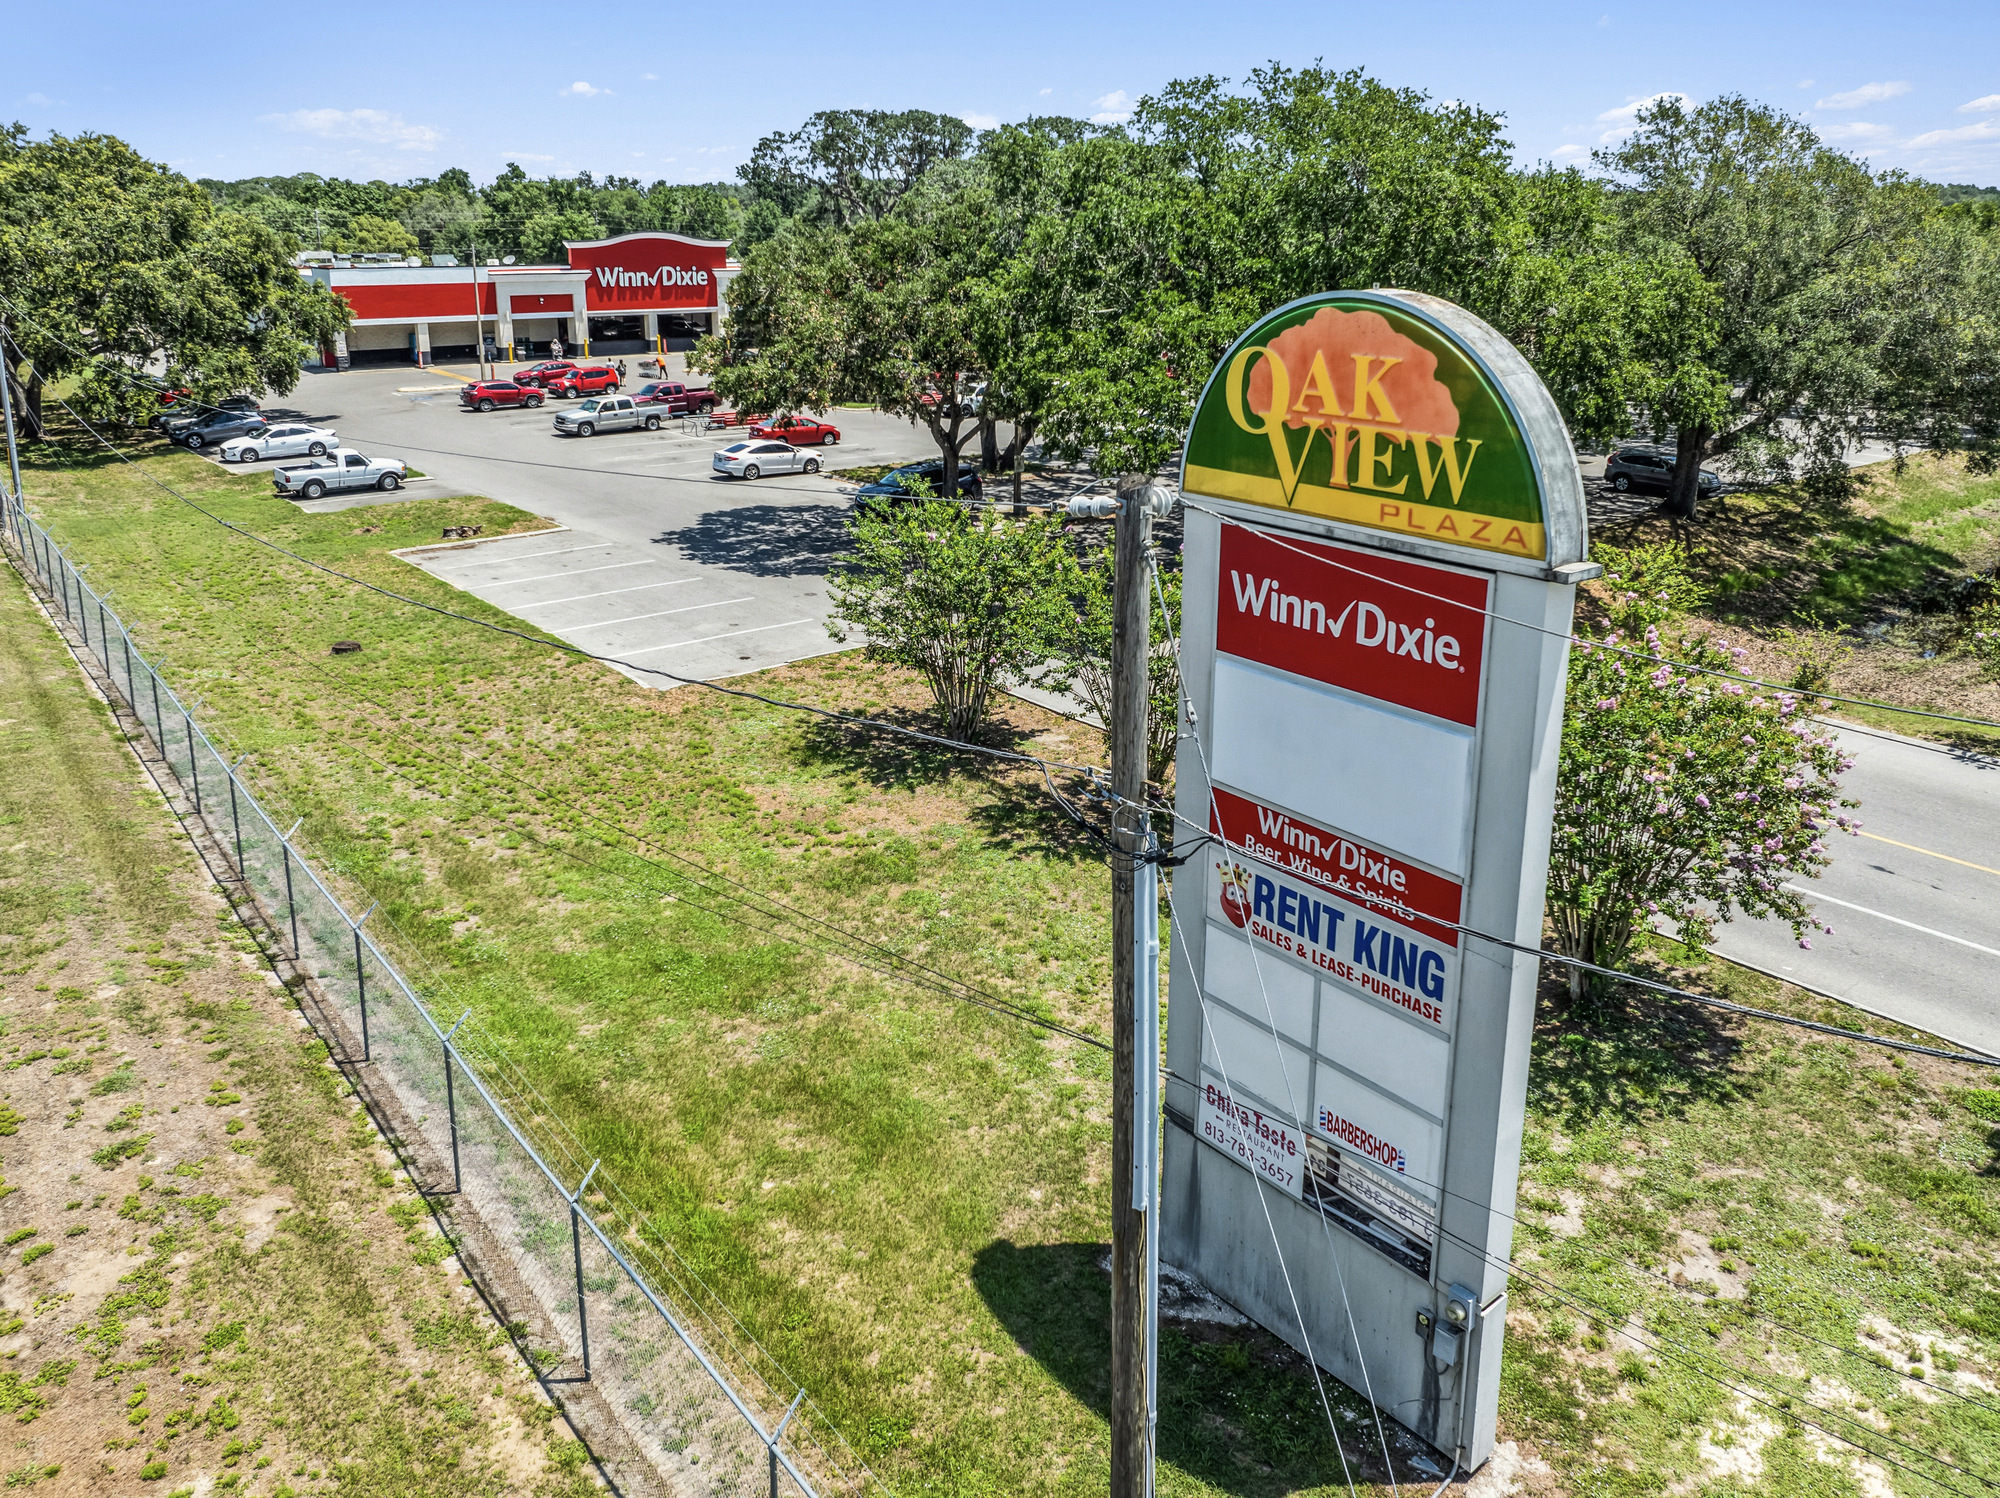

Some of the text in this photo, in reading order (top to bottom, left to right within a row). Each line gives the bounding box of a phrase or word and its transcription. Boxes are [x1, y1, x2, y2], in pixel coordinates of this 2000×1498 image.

[596, 265, 708, 288] Winn Dixie
[1225, 345, 1405, 435] OAK
[1258, 411, 1483, 507] VIEW
[1379, 503, 1528, 551] PLAZA
[1230, 569, 1461, 671] Winn Dixie
[1256, 805, 1406, 892] Winn Dixie
[1289, 851, 1332, 883] Wine
[1338, 873, 1352, 892] &
[1355, 880, 1416, 922] Spirits
[1251, 920, 1442, 1025] SALES & LEASE-PURCHASE
[1253, 873, 1445, 1003] RENT KING
[1204, 1121, 1294, 1187] 813-783-3657
[1206, 1084, 1296, 1157] China Taste
[1225, 1119, 1285, 1163] RESTAURANT
[1326, 1110, 1398, 1168] BARBERSHOP
